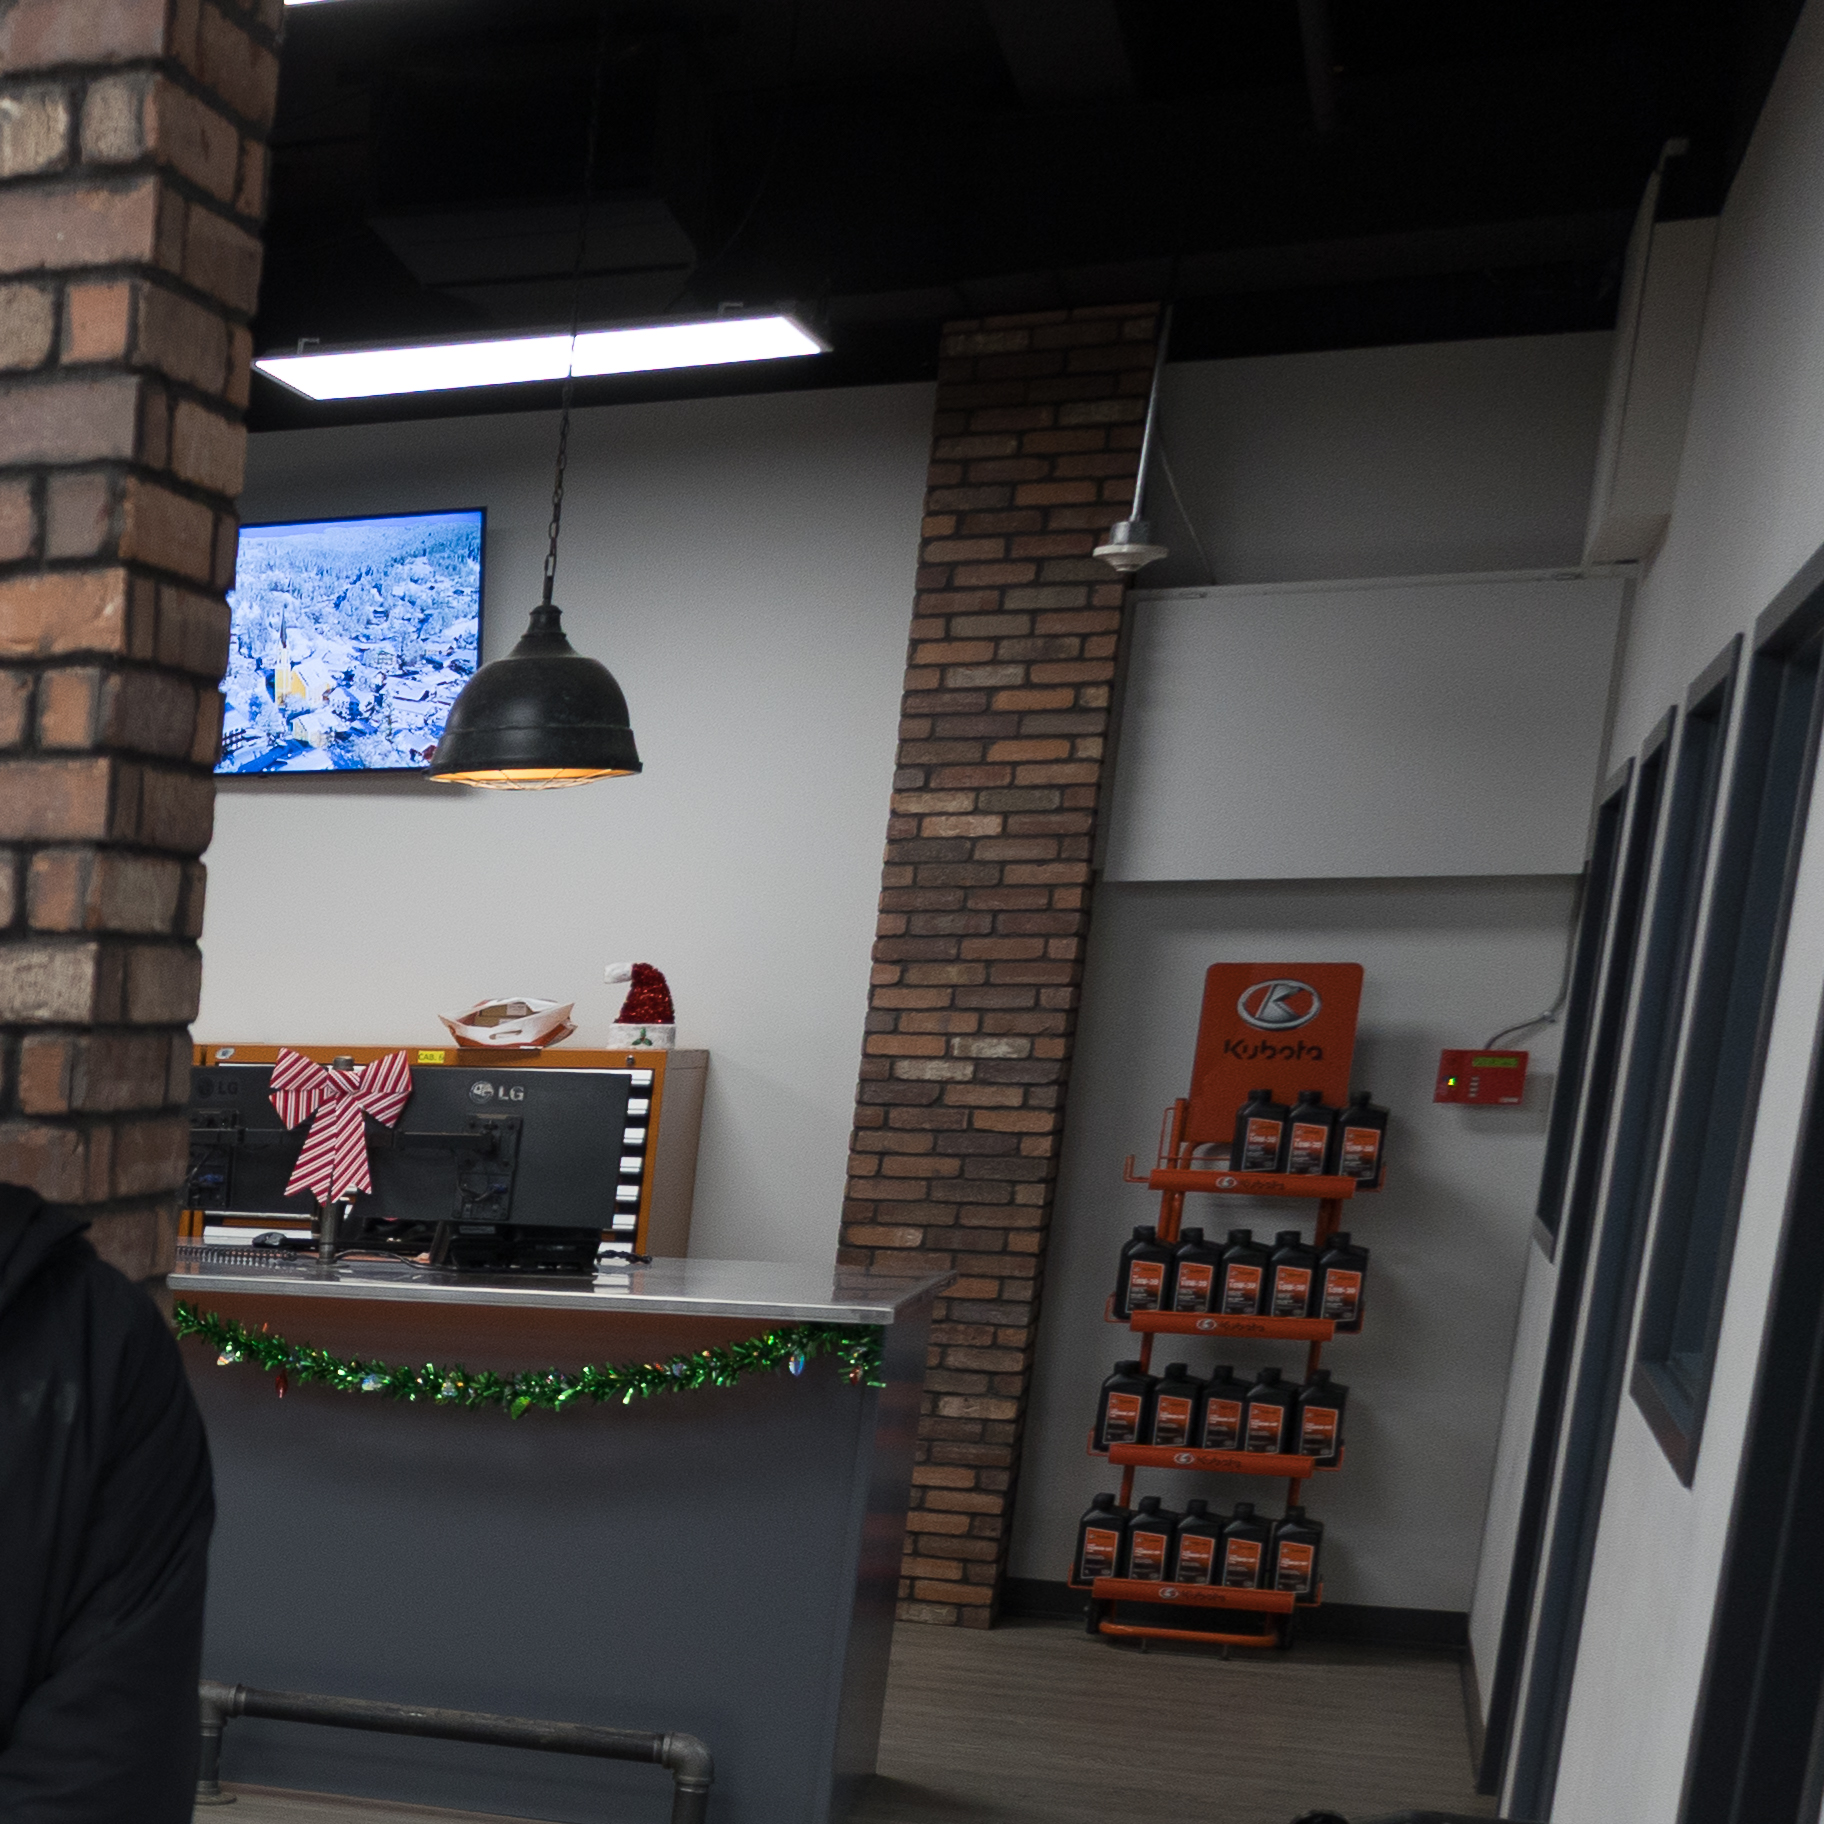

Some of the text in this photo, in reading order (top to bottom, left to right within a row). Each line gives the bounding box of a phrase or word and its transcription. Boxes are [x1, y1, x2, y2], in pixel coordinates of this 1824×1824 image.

[1223, 1038, 1324, 1062] Kubota
[217, 1083, 238, 1095] LG
[499, 1086, 525, 1101] LG
